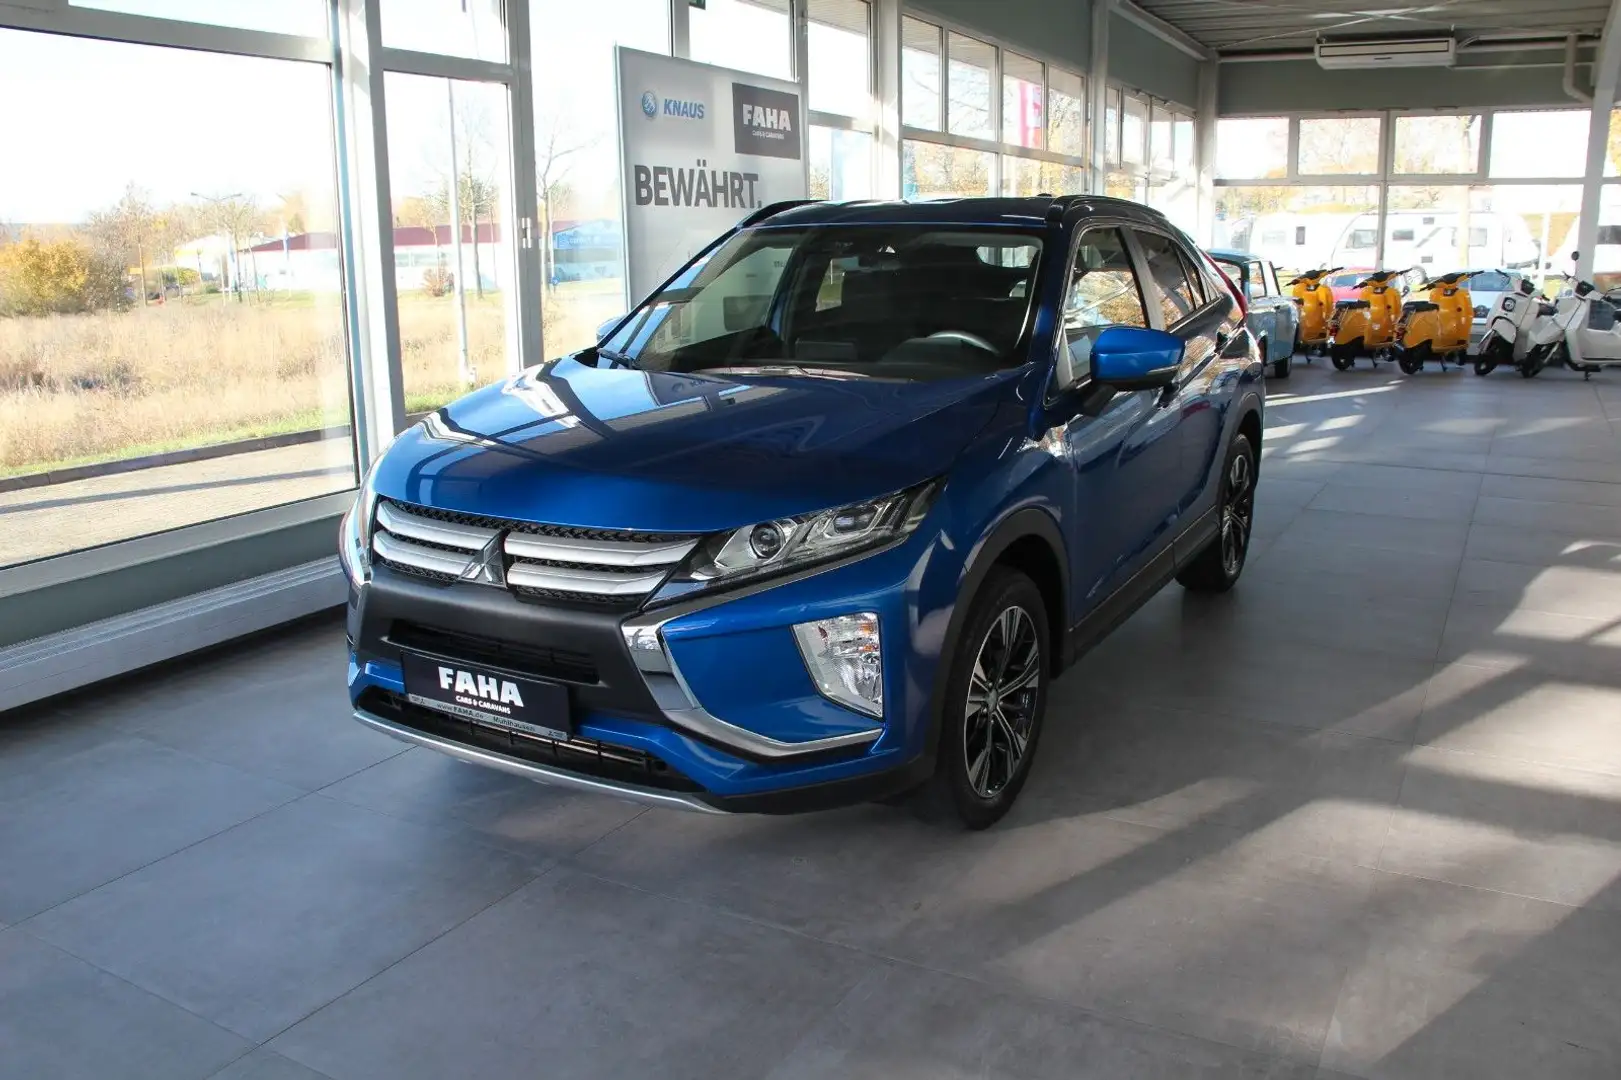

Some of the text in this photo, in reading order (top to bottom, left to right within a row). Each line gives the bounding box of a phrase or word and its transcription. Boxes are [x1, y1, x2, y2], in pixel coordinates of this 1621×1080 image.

[663, 98, 704, 119] KNAUS
[742, 103, 792, 132] FAHA
[634, 159, 762, 209] BEWÄHRT.
[438, 666, 524, 707] FAHA
